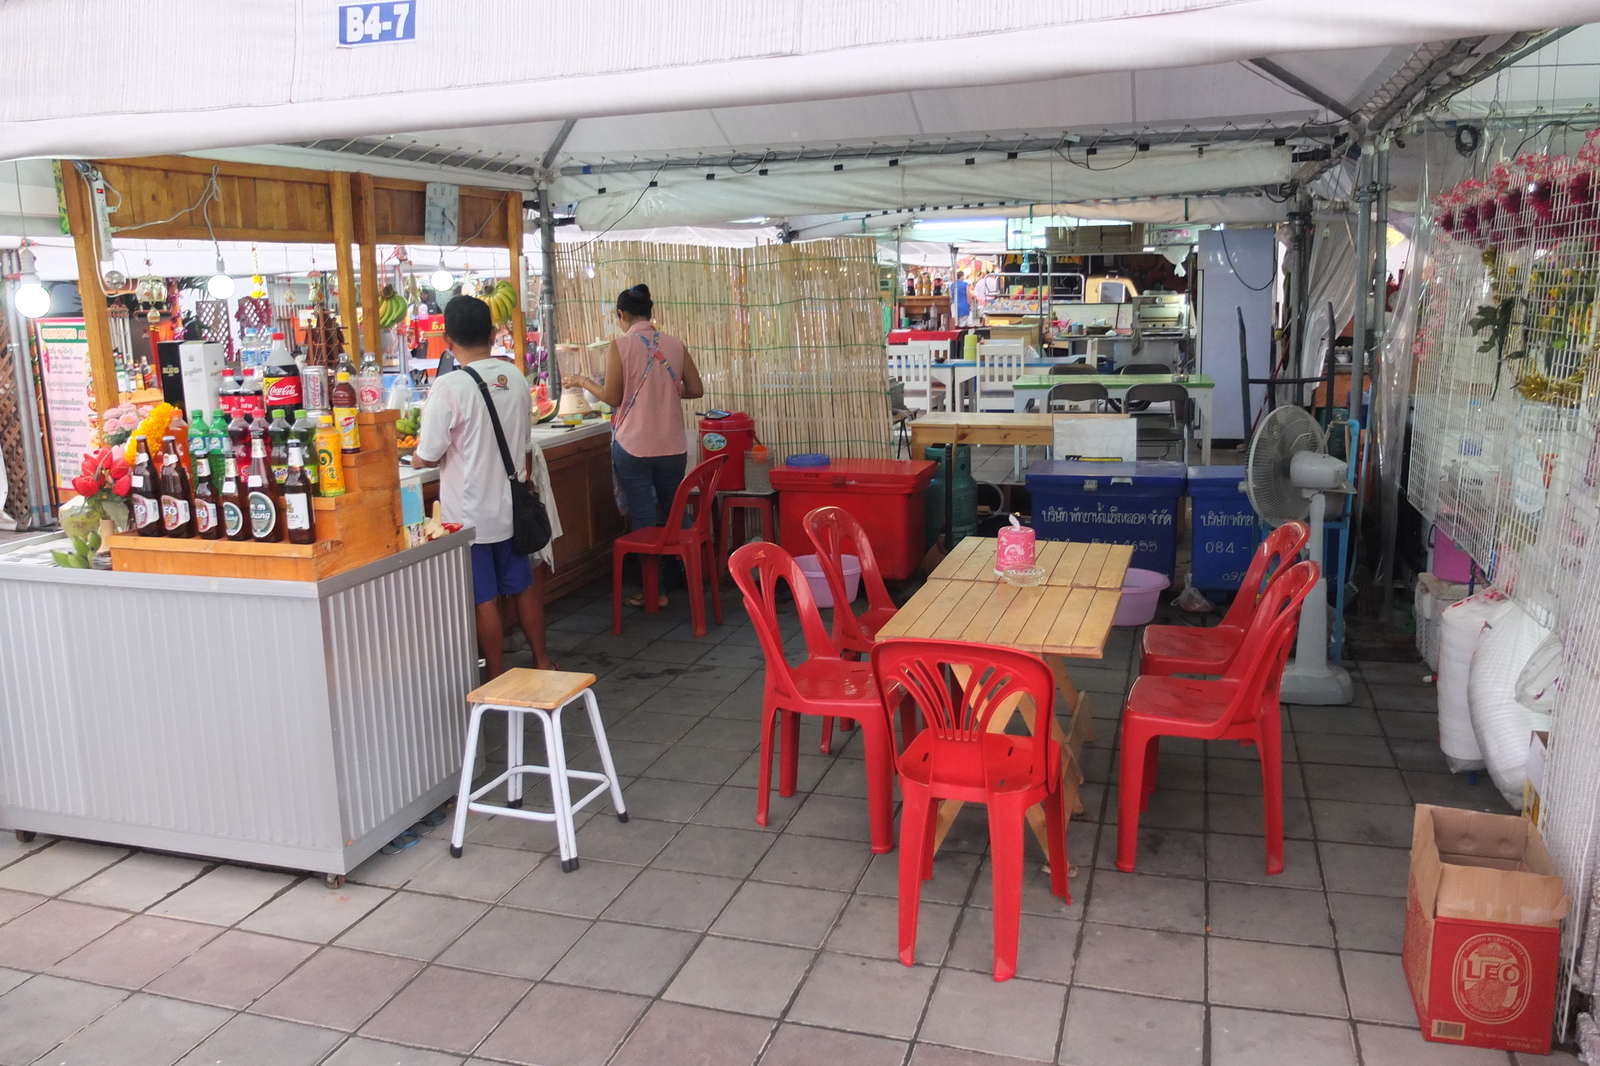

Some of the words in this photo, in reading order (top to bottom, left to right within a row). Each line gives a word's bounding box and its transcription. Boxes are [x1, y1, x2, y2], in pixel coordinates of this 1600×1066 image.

[346, 3, 410, 43] B4-7
[432, 321, 446, 330] Бл
[269, 384, 297, 396] Coca-Cola
[134, 504, 146, 513] EO
[164, 505, 177, 515] EO
[197, 510, 207, 518] EO
[1205, 540, 1235, 554] 084
[1462, 959, 1523, 986] LEO
